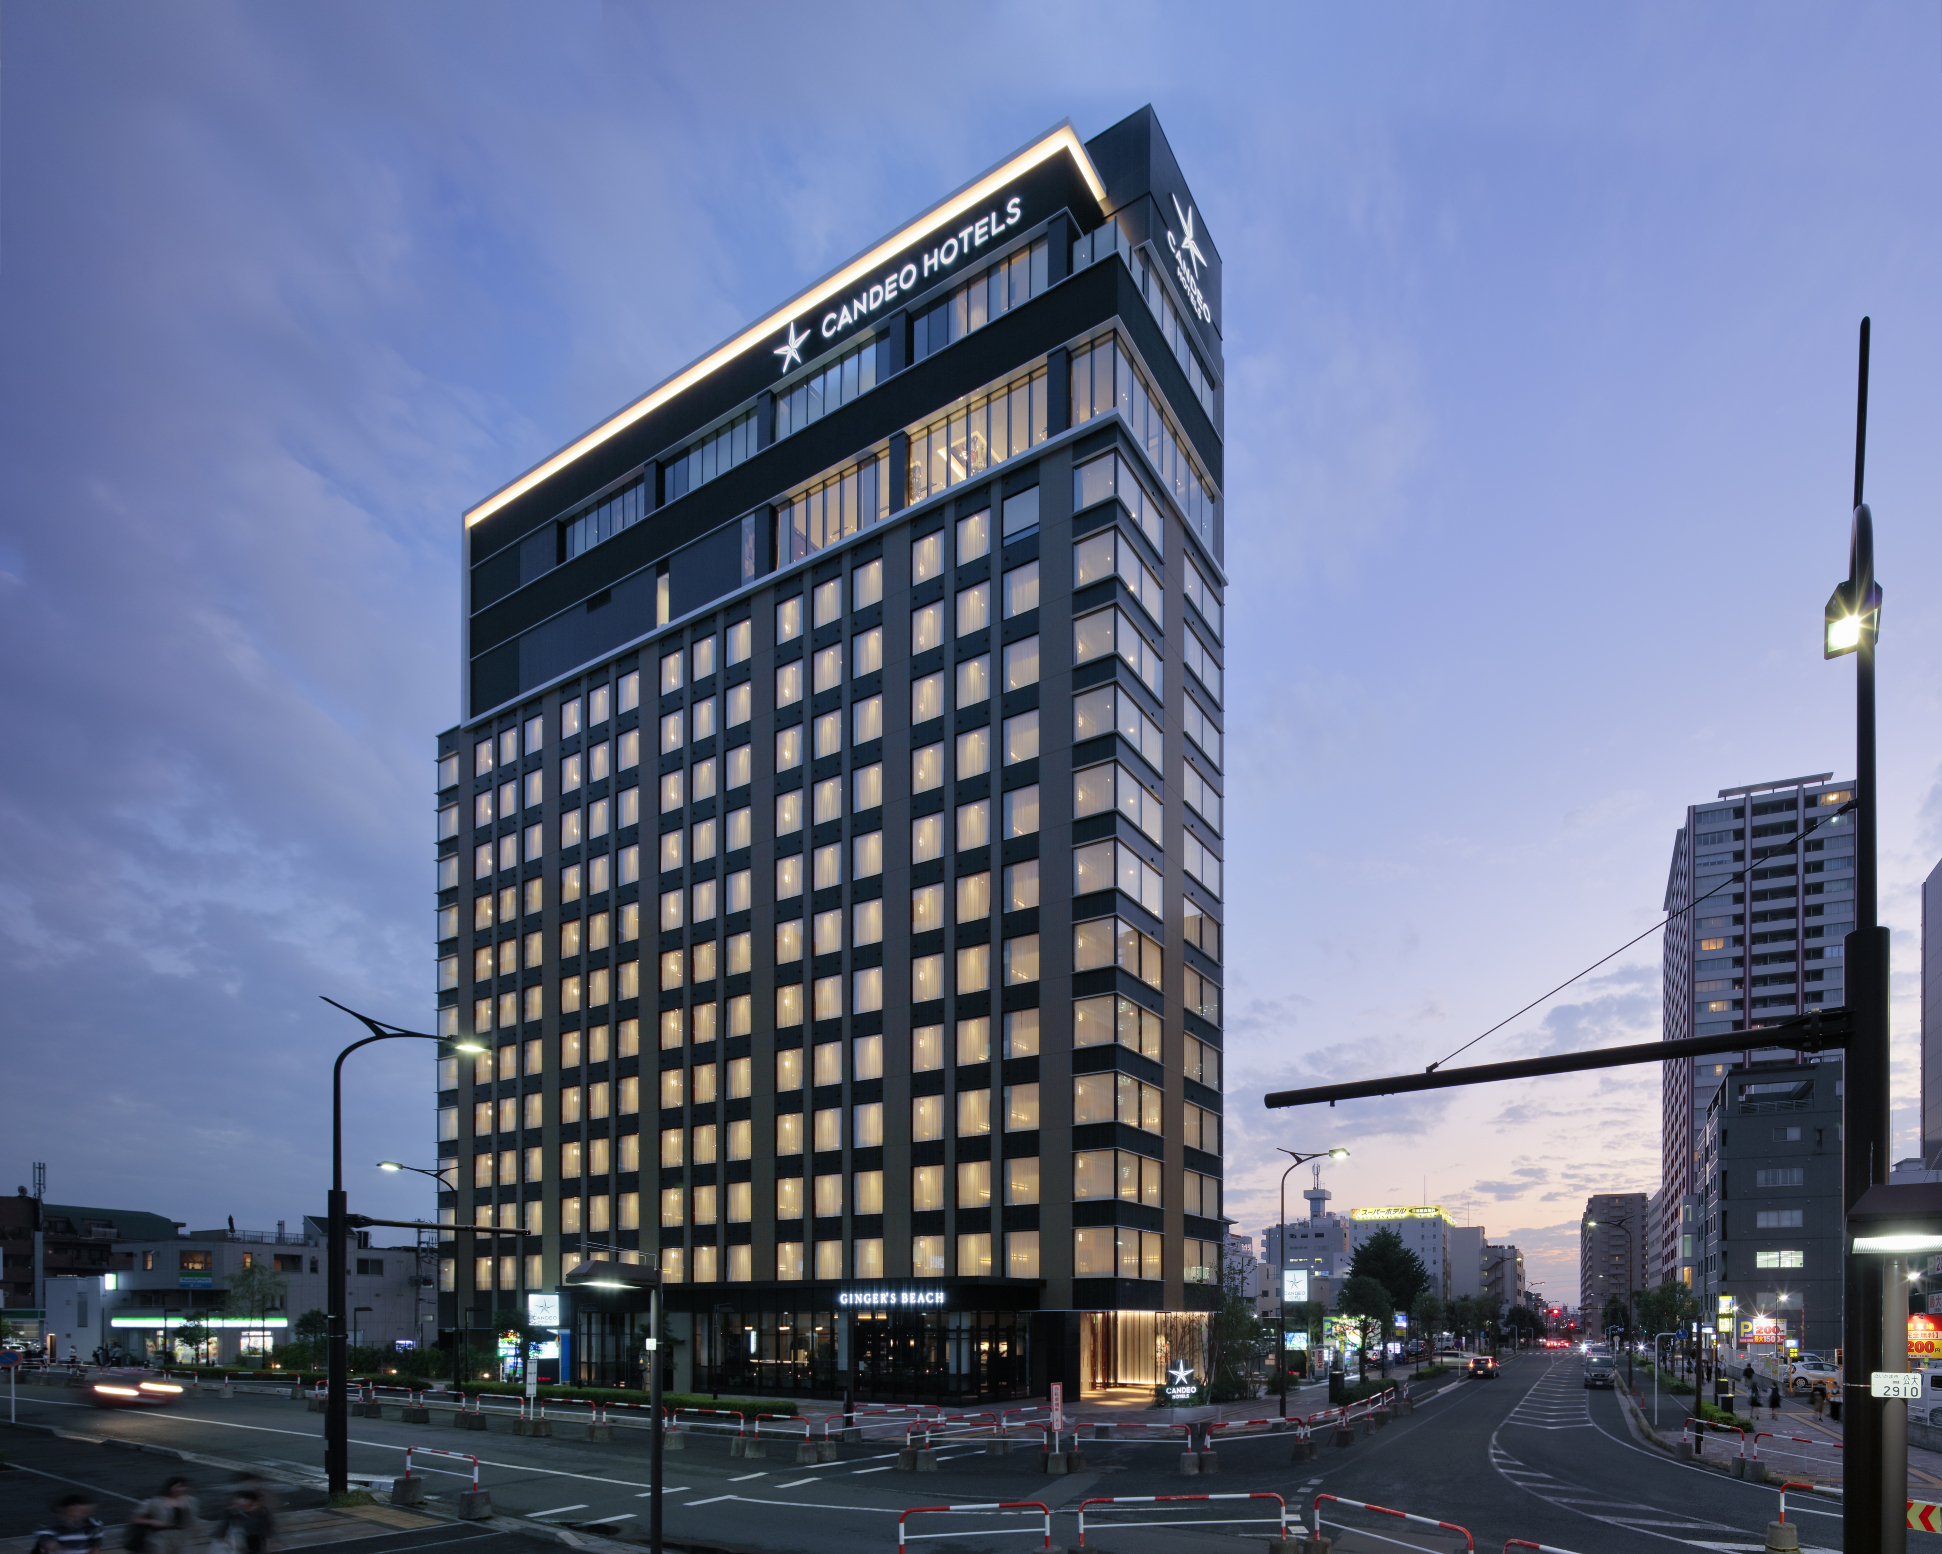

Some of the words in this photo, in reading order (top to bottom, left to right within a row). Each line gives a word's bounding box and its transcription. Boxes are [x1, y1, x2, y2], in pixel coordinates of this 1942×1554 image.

[821, 263, 917, 338] CANDEO
[923, 197, 1021, 278] HOTELS
[1167, 230, 1211, 323] CANDEO
[1177, 266, 1202, 320] HOTELS
[1361, 1207, 1407, 1216] スーパーホテル
[840, 1292, 896, 1304] GINGER'S
[901, 1292, 944, 1303] BEACH
[1324, 1322, 1331, 1331] P
[1740, 1321, 1752, 1337] P
[499, 1348, 508, 1357] P
[1903, 1374, 1919, 1386] 公大
[1165, 1386, 1197, 1395] CANDEO
[1883, 1386, 1919, 1397] 2910
